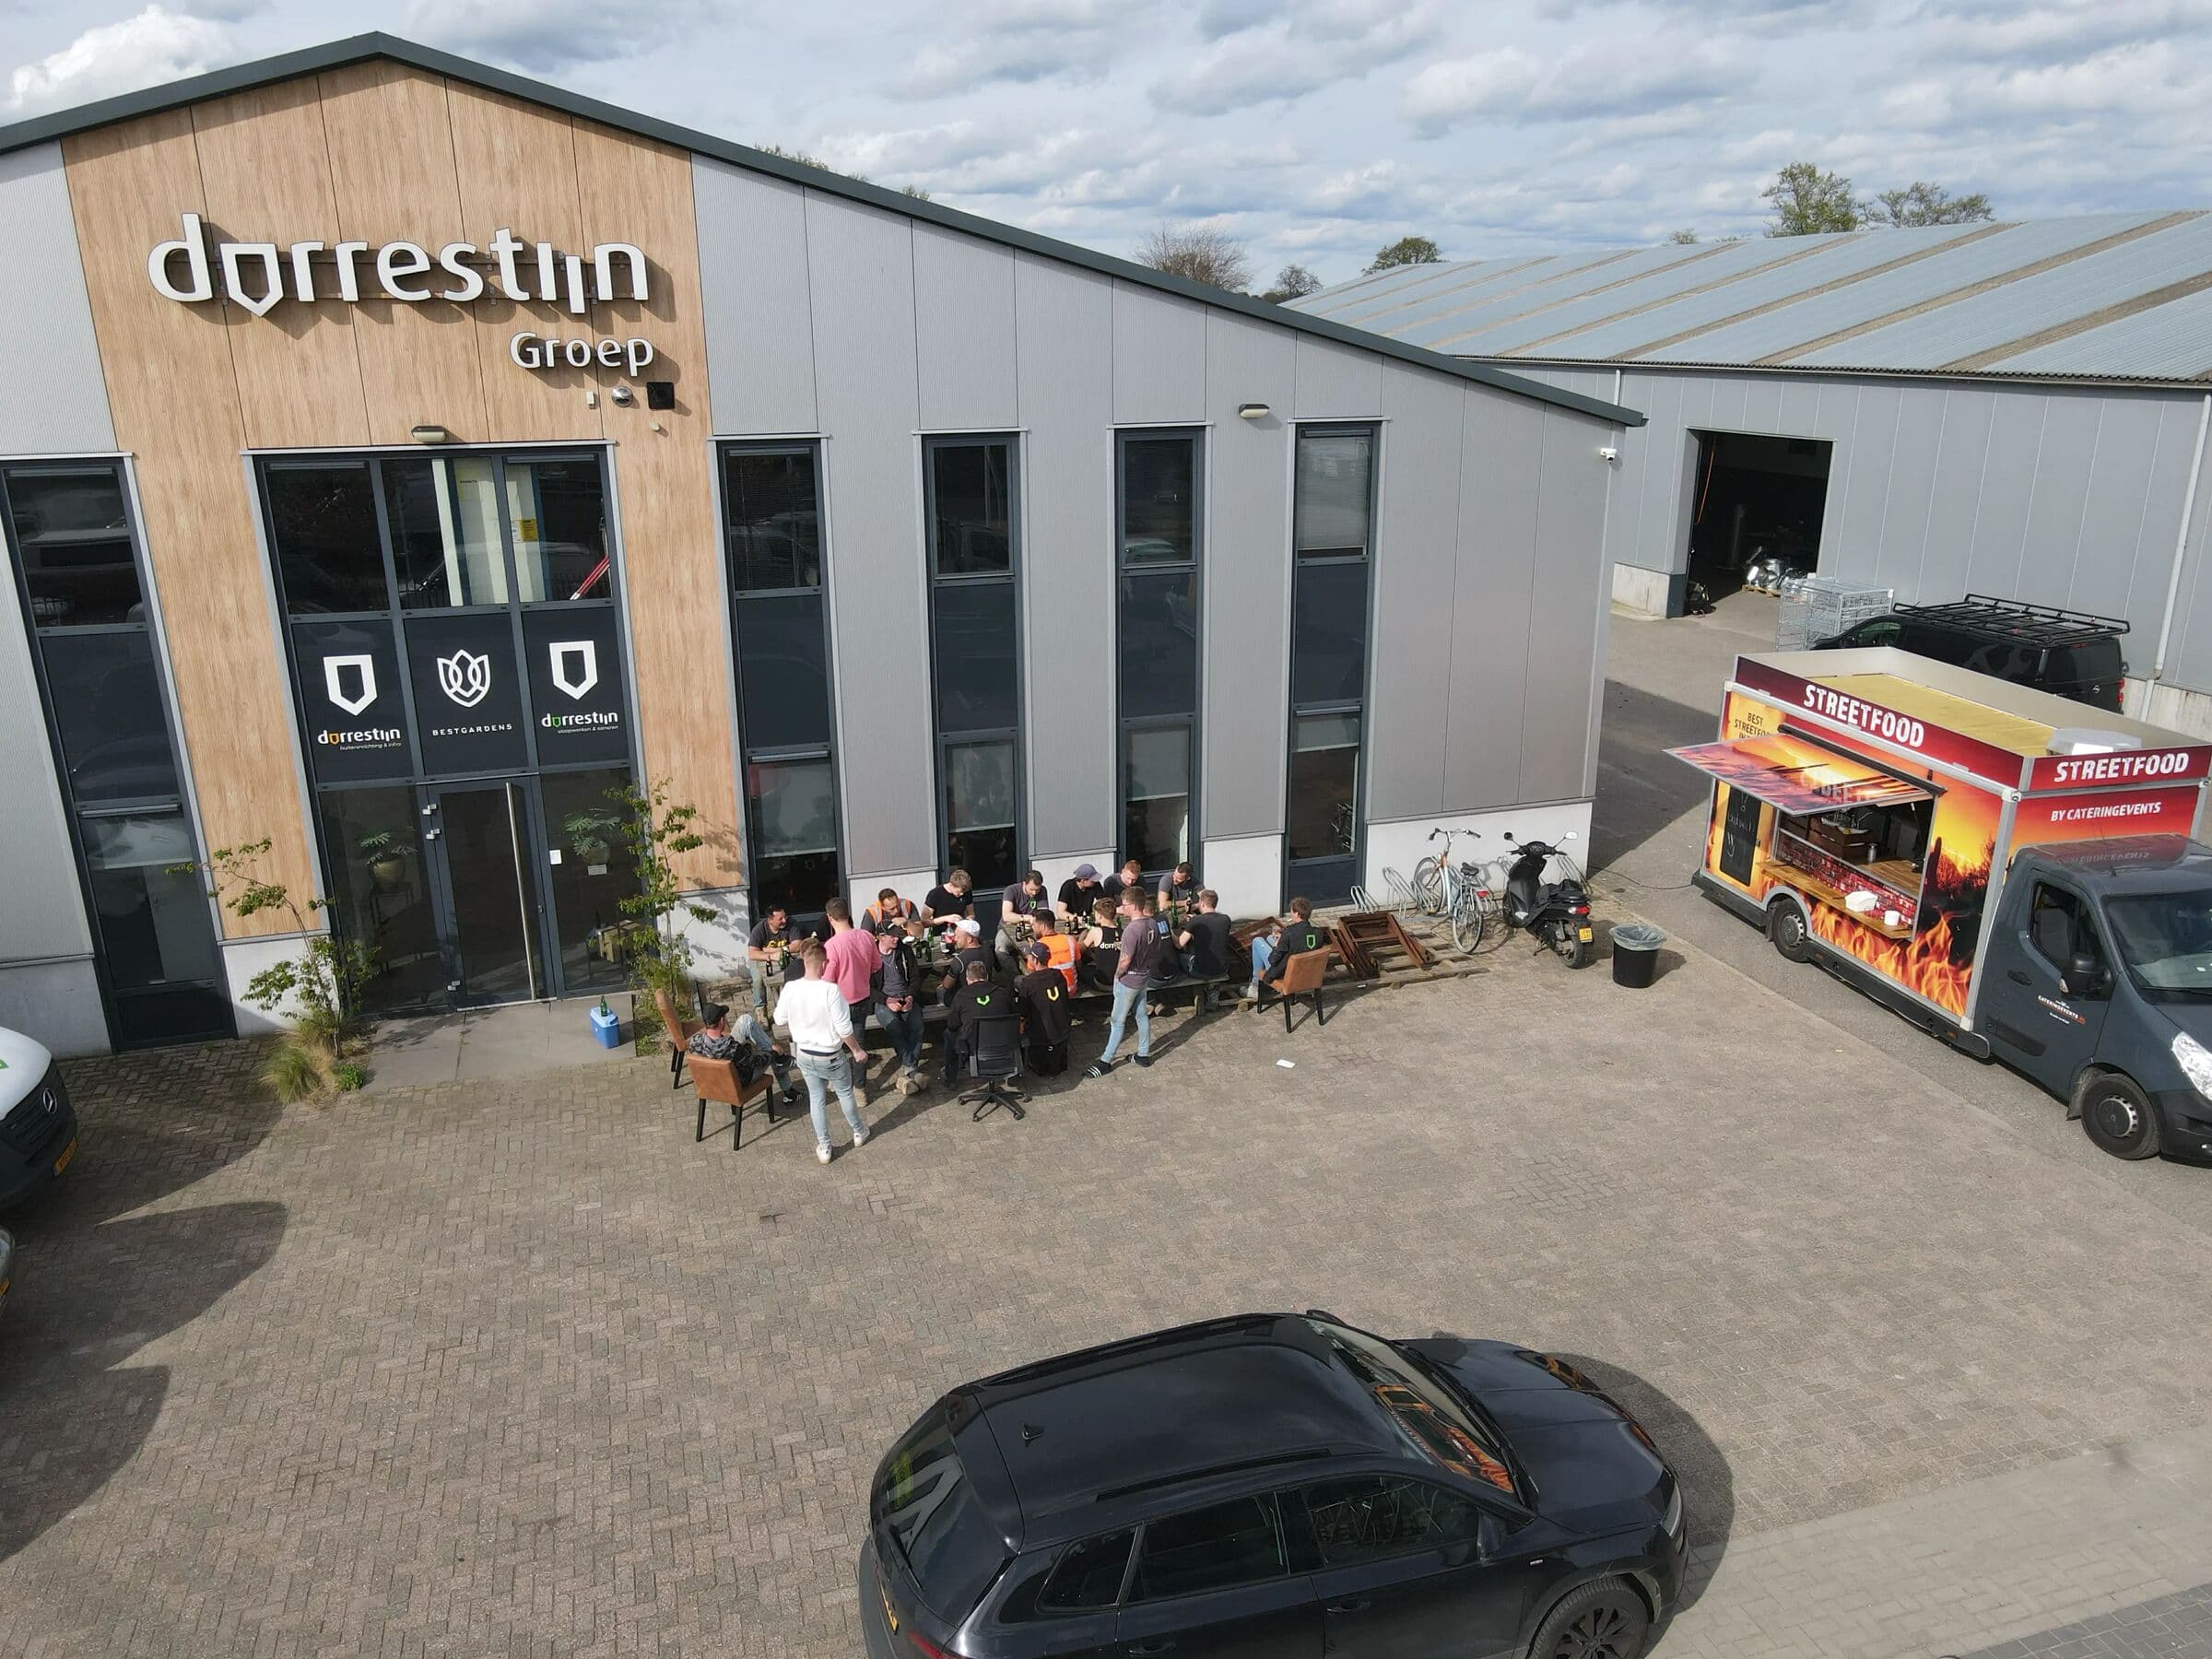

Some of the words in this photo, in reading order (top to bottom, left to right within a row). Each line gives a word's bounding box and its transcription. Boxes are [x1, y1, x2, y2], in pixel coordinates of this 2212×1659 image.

[510, 331, 653, 377] Groep
[1747, 712, 1764, 726] BEST
[1803, 684, 1924, 747] STREETFOOD
[432, 724, 513, 736] BESTGARDENS
[1734, 719, 1771, 736] STREETFO
[2053, 752, 2190, 782] STREETFOOD
[2051, 809, 2066, 822] BY
[2066, 802, 2162, 820] CATERINGEVENTS
